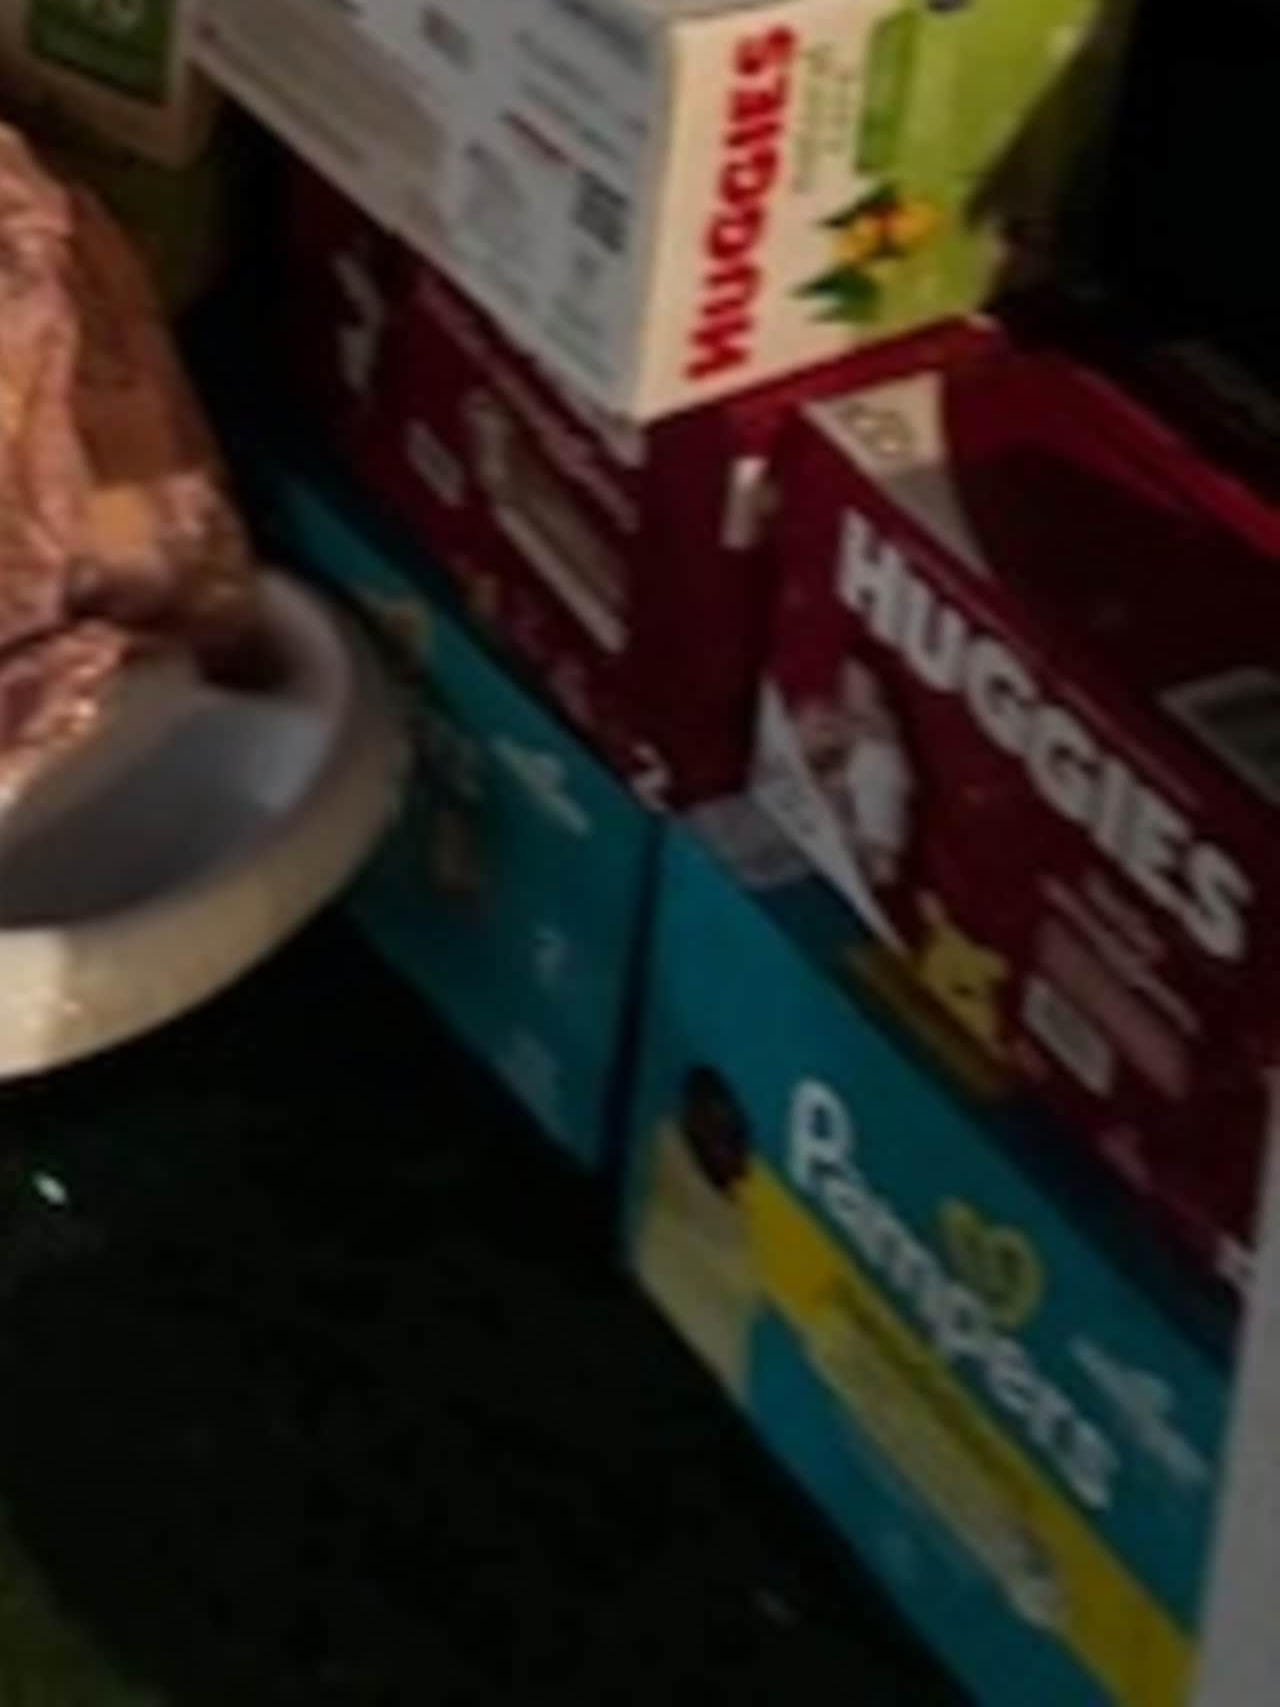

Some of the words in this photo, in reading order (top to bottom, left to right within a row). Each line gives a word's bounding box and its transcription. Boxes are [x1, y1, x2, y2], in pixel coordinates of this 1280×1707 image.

[685, 24, 798, 382] HUGGIES
[837, 507, 1254, 960] HUGGIES
[790, 1080, 1120, 1511] Pampers
